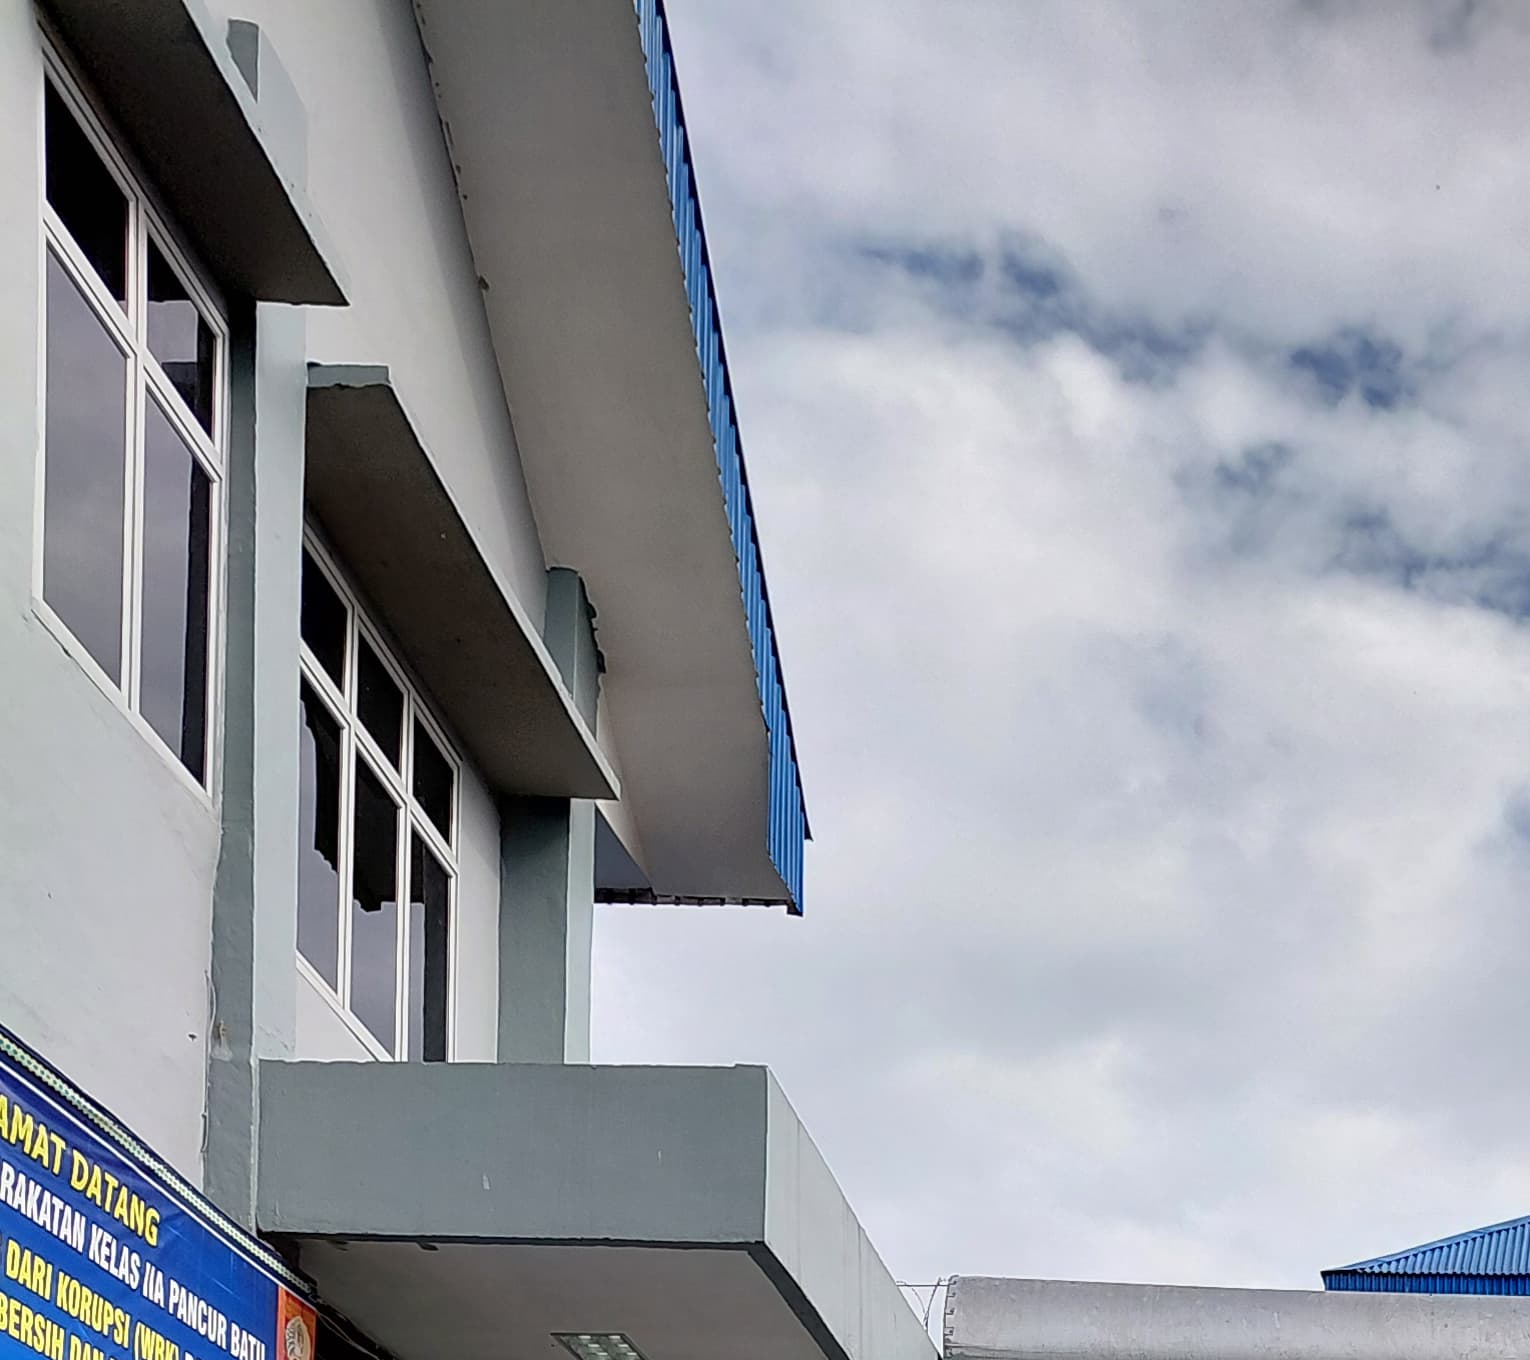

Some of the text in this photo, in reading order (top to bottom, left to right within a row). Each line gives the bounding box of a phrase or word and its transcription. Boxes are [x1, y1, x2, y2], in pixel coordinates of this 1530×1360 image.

[71, 1150, 160, 1246] DATANG
[1, 1161, 86, 1253] RAKATAN
[88, 1223, 141, 1290] KELAS
[169, 1279, 227, 1349] PANCUR
[6, 1239, 53, 1300] DARI
[56, 1271, 131, 1348] KORUPSI
